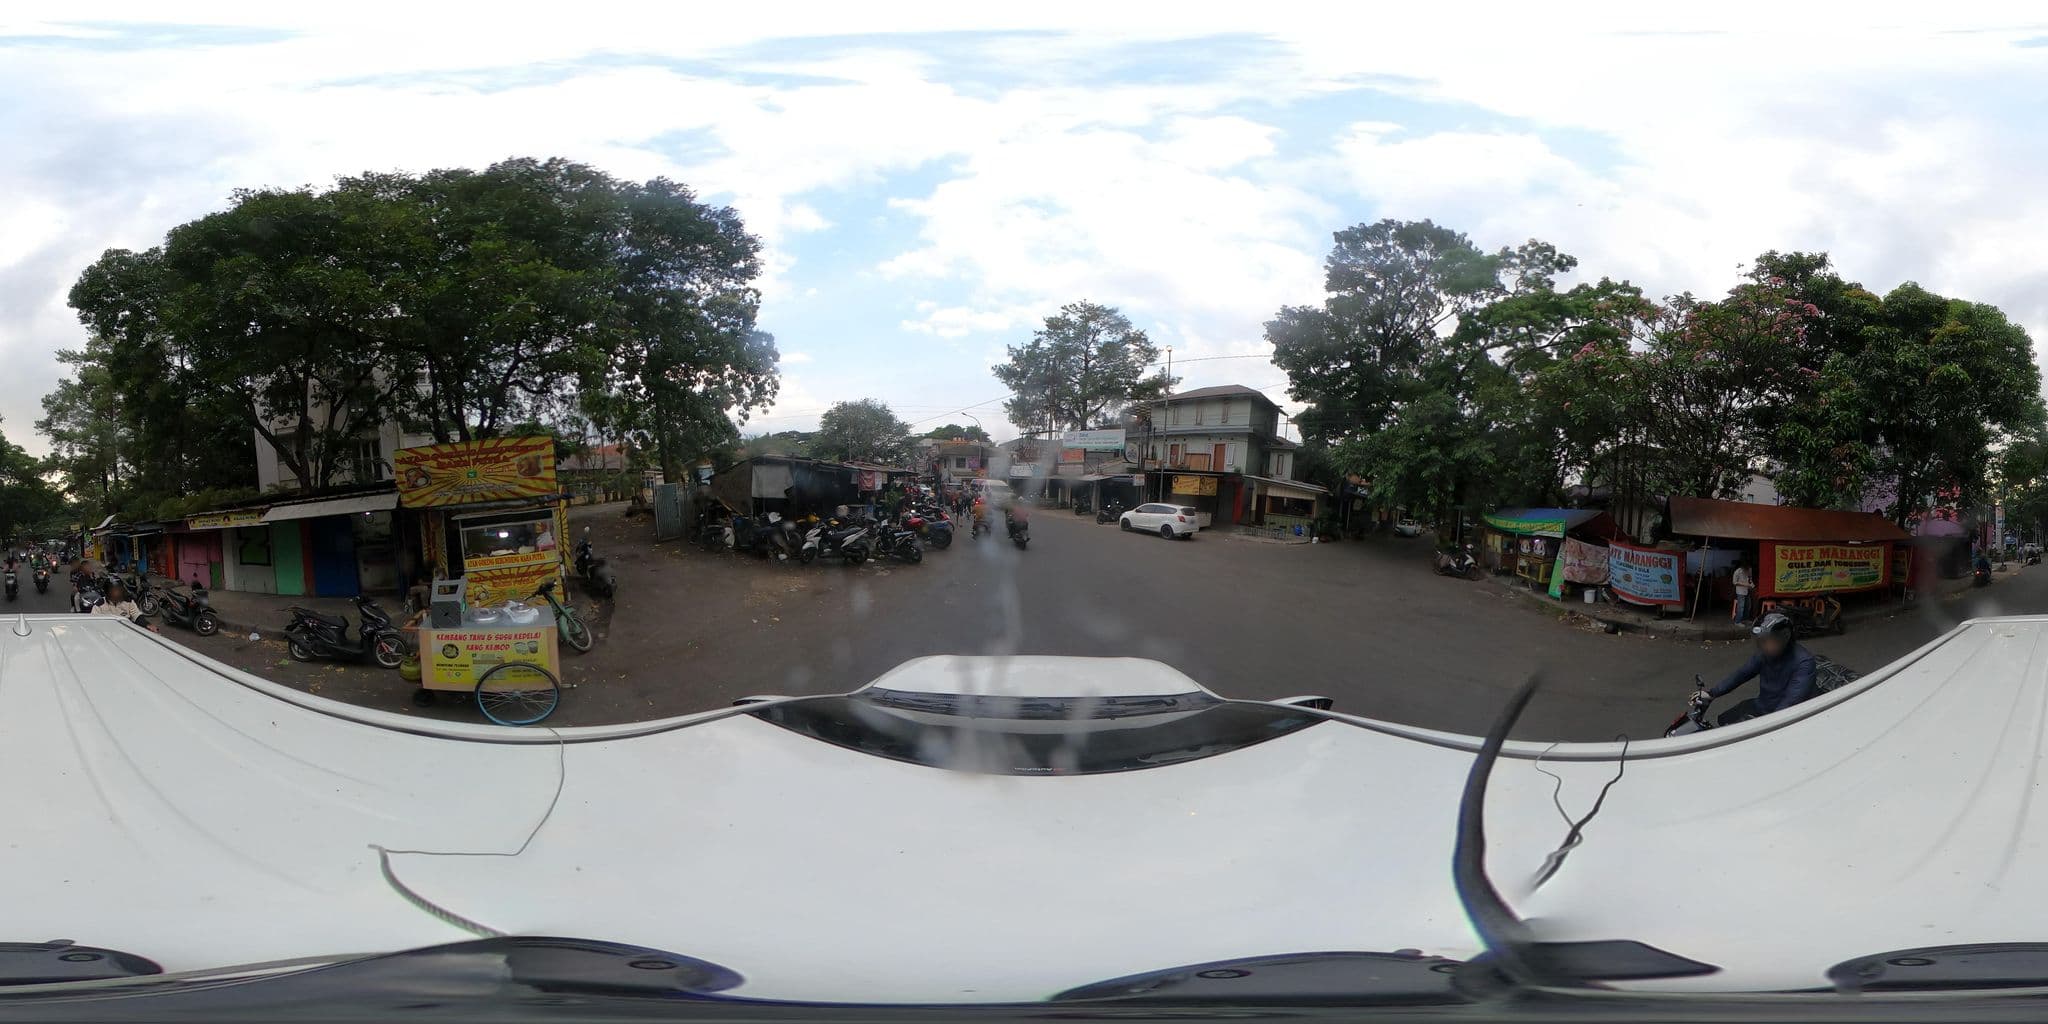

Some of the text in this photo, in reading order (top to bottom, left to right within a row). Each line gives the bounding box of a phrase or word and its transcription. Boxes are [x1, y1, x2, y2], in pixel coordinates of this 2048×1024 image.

[1780, 548, 1880, 560] SATE MARANGGI
[1788, 561, 1812, 569] GULE
[1814, 560, 1832, 568] DAN
[436, 633, 467, 641] KEMBANG
[469, 633, 485, 641] TAHU
[495, 633, 512, 641] SUSU
[513, 632, 541, 640] KEDELAI
